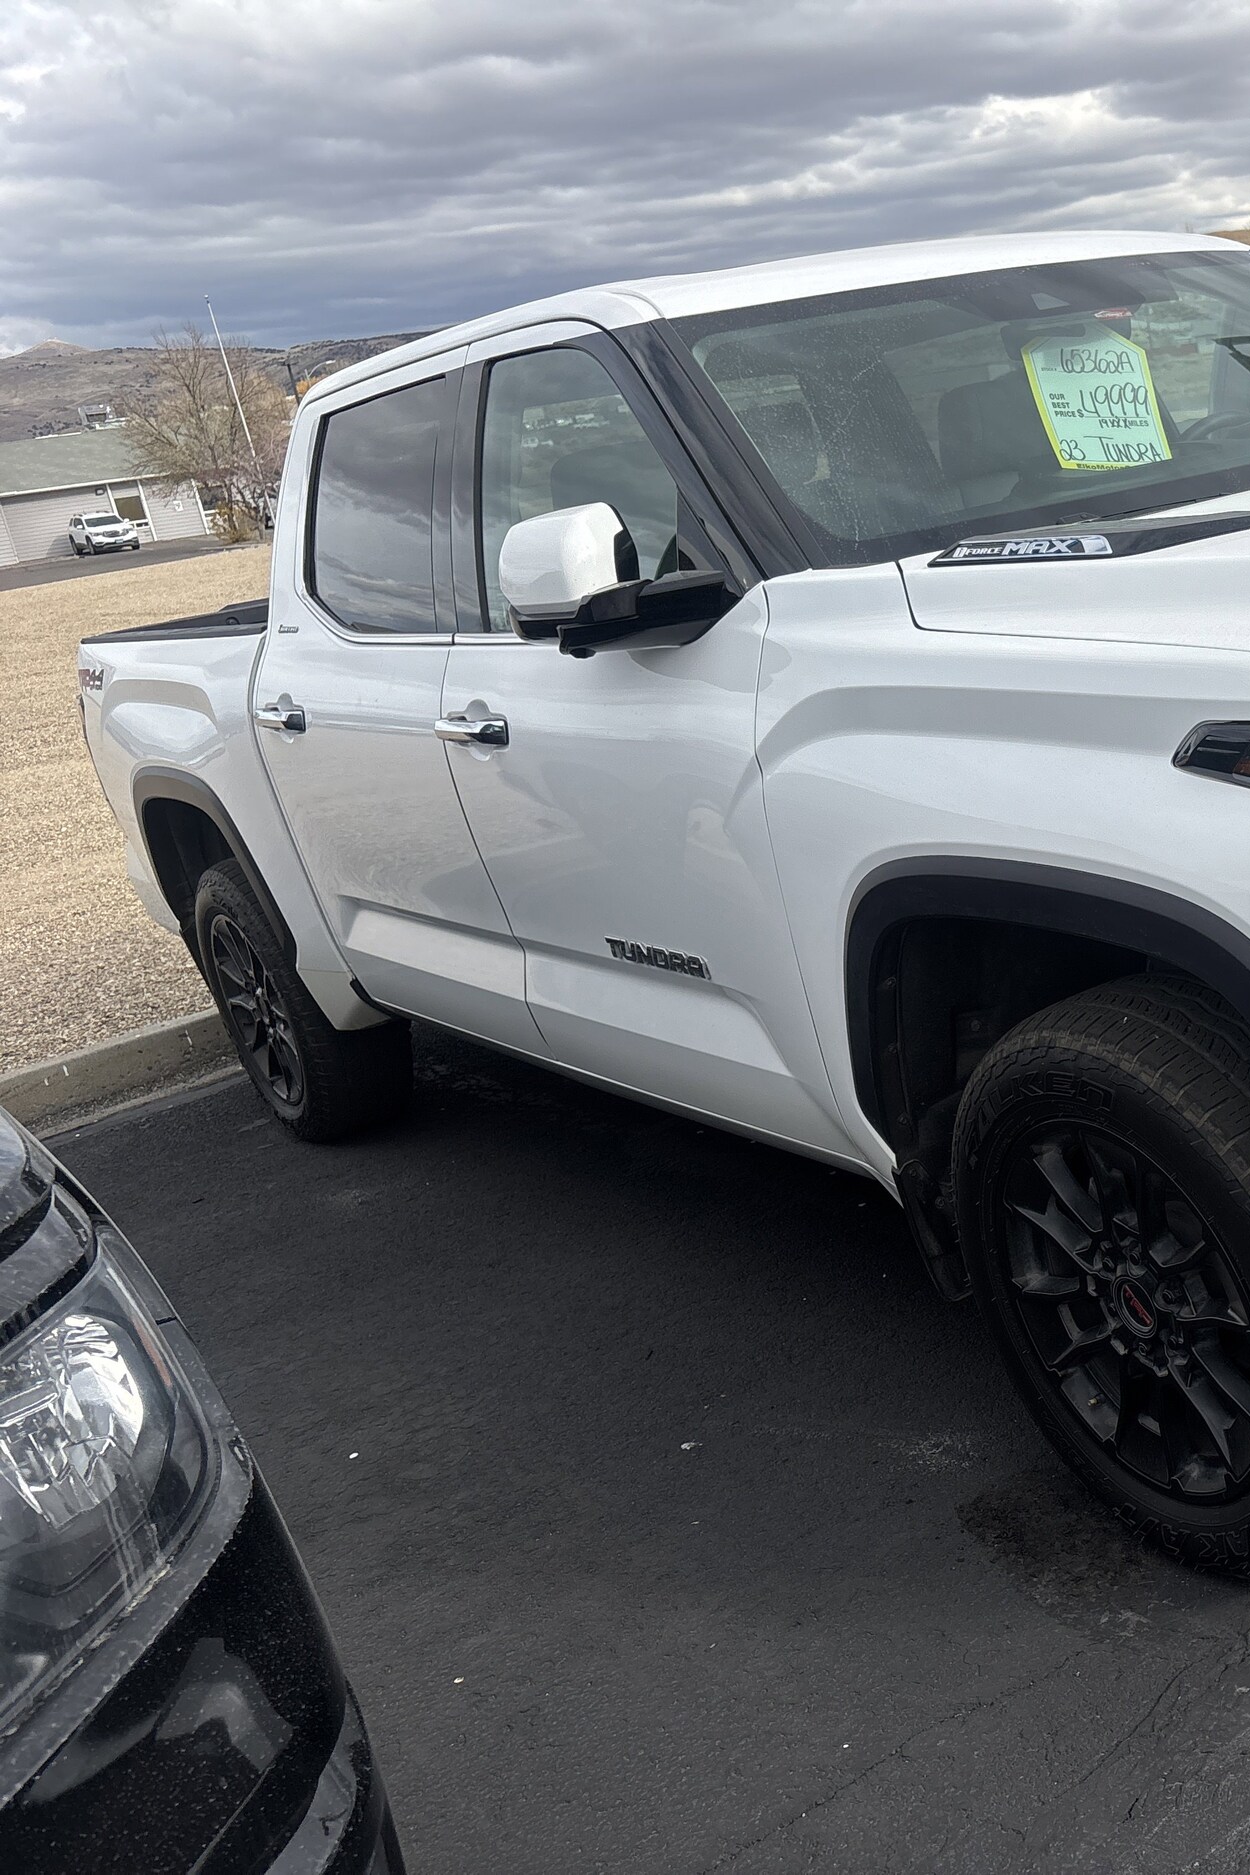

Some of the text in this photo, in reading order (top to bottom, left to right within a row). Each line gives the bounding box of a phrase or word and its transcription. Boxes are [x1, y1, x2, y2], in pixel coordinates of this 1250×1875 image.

[1060, 348, 1135, 374] 65362A
[1049, 392, 1066, 401] OUR
[1052, 401, 1070, 409] BEST
[1054, 409, 1076, 418] PRICE
[1077, 408, 1085, 418] $
[1059, 435, 1162, 463] 23 TUNDRA
[1001, 540, 1075, 555] MAX
[604, 935, 712, 980] TUNDRA
